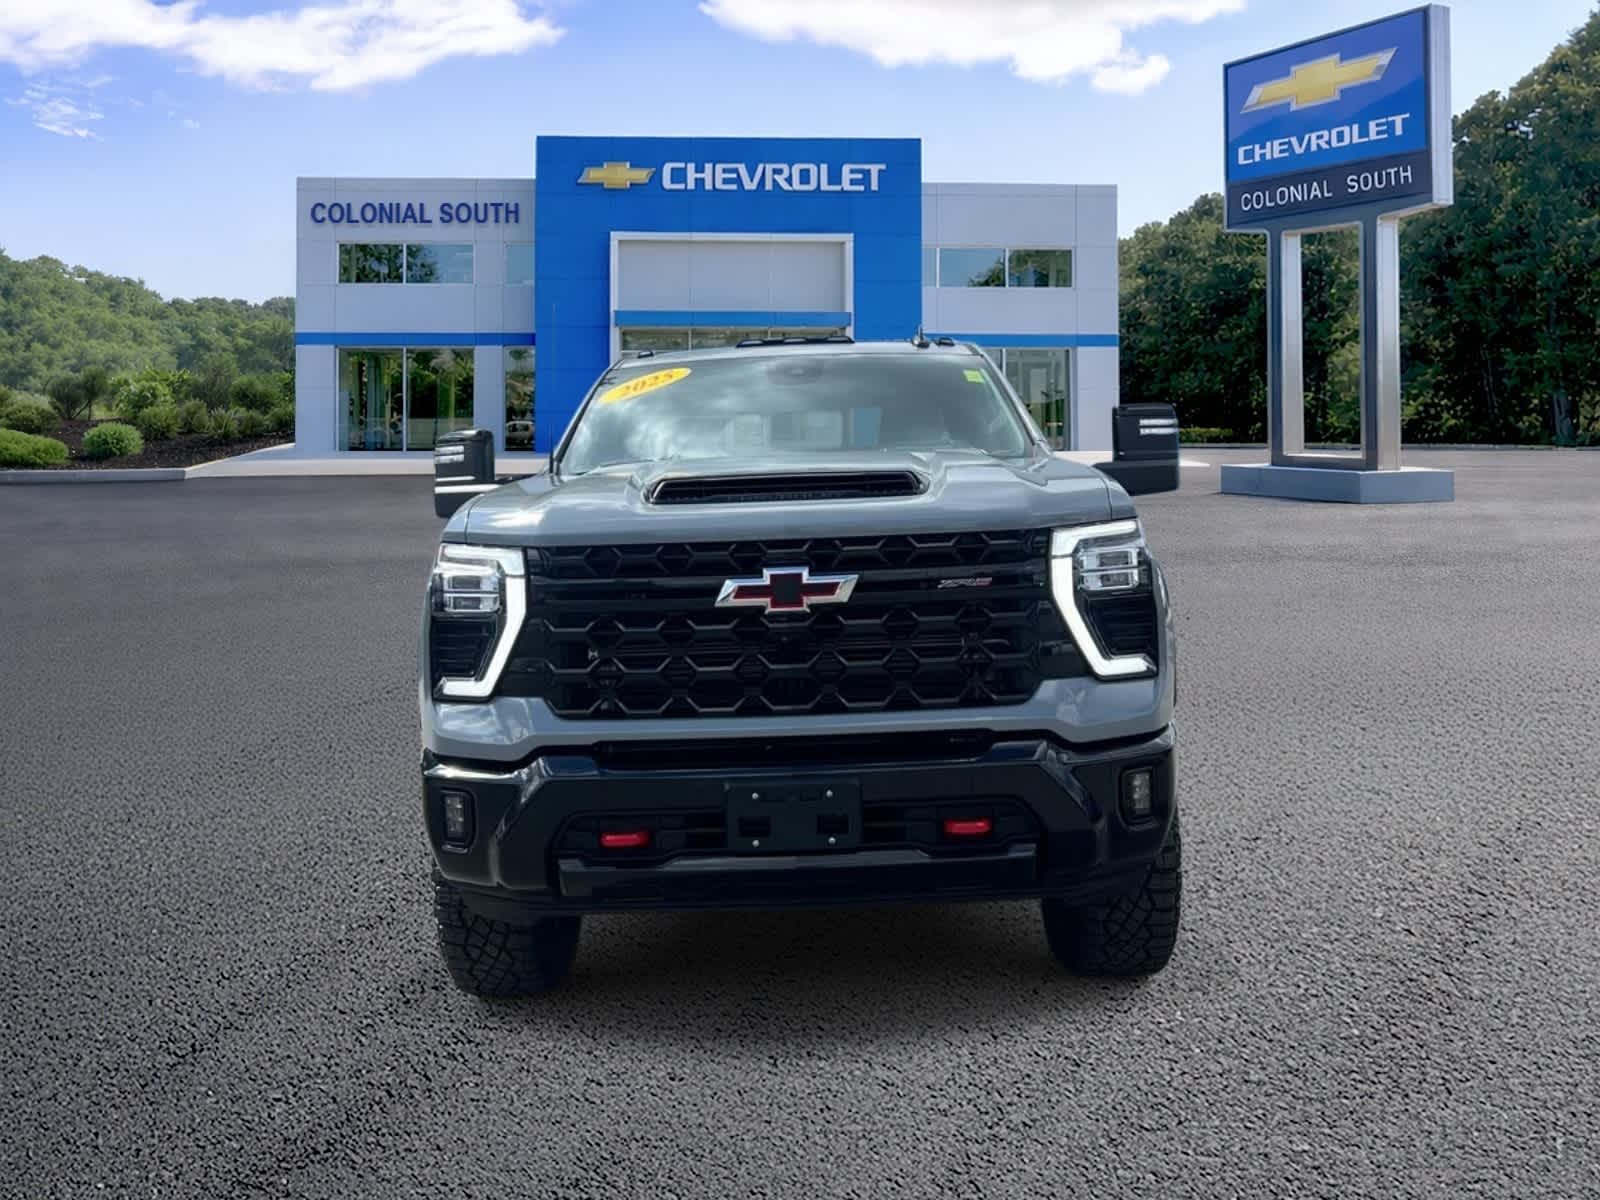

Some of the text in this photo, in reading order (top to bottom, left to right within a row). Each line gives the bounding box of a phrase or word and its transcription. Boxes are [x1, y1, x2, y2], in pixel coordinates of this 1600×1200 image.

[1238, 113, 1410, 165] CHEVROLET
[662, 162, 886, 191] CHEVROLET
[1241, 165, 1412, 211] COLONIAL SOUTH
[311, 203, 519, 224] COLONIAL SOUTH
[619, 369, 676, 396] 2025
